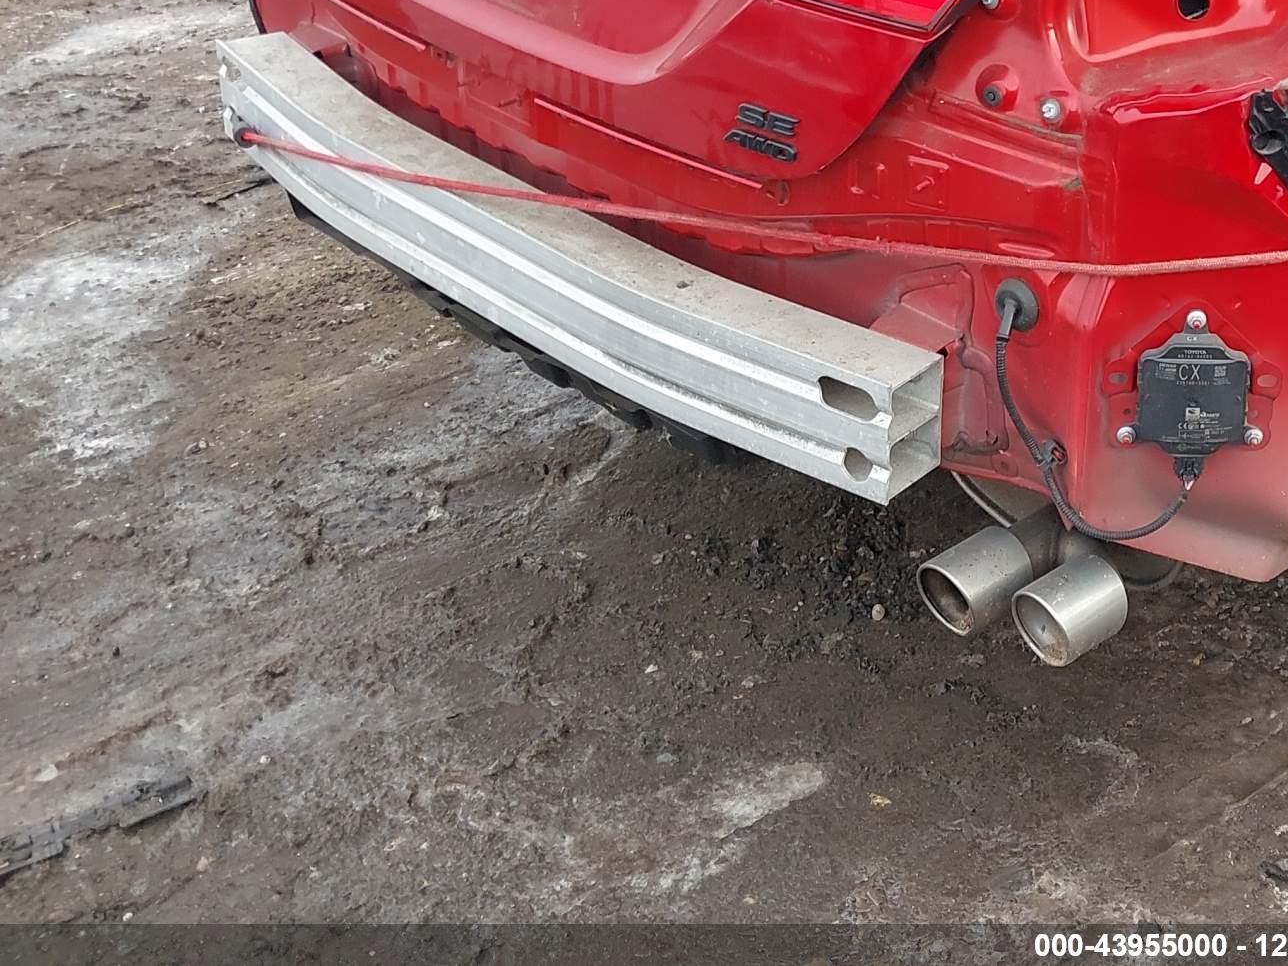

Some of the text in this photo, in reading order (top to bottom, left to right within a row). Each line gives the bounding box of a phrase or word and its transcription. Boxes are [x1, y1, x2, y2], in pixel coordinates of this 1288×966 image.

[735, 101, 800, 137] SE
[723, 128, 798, 162] AWD
[1178, 364, 1201, 381] CX
